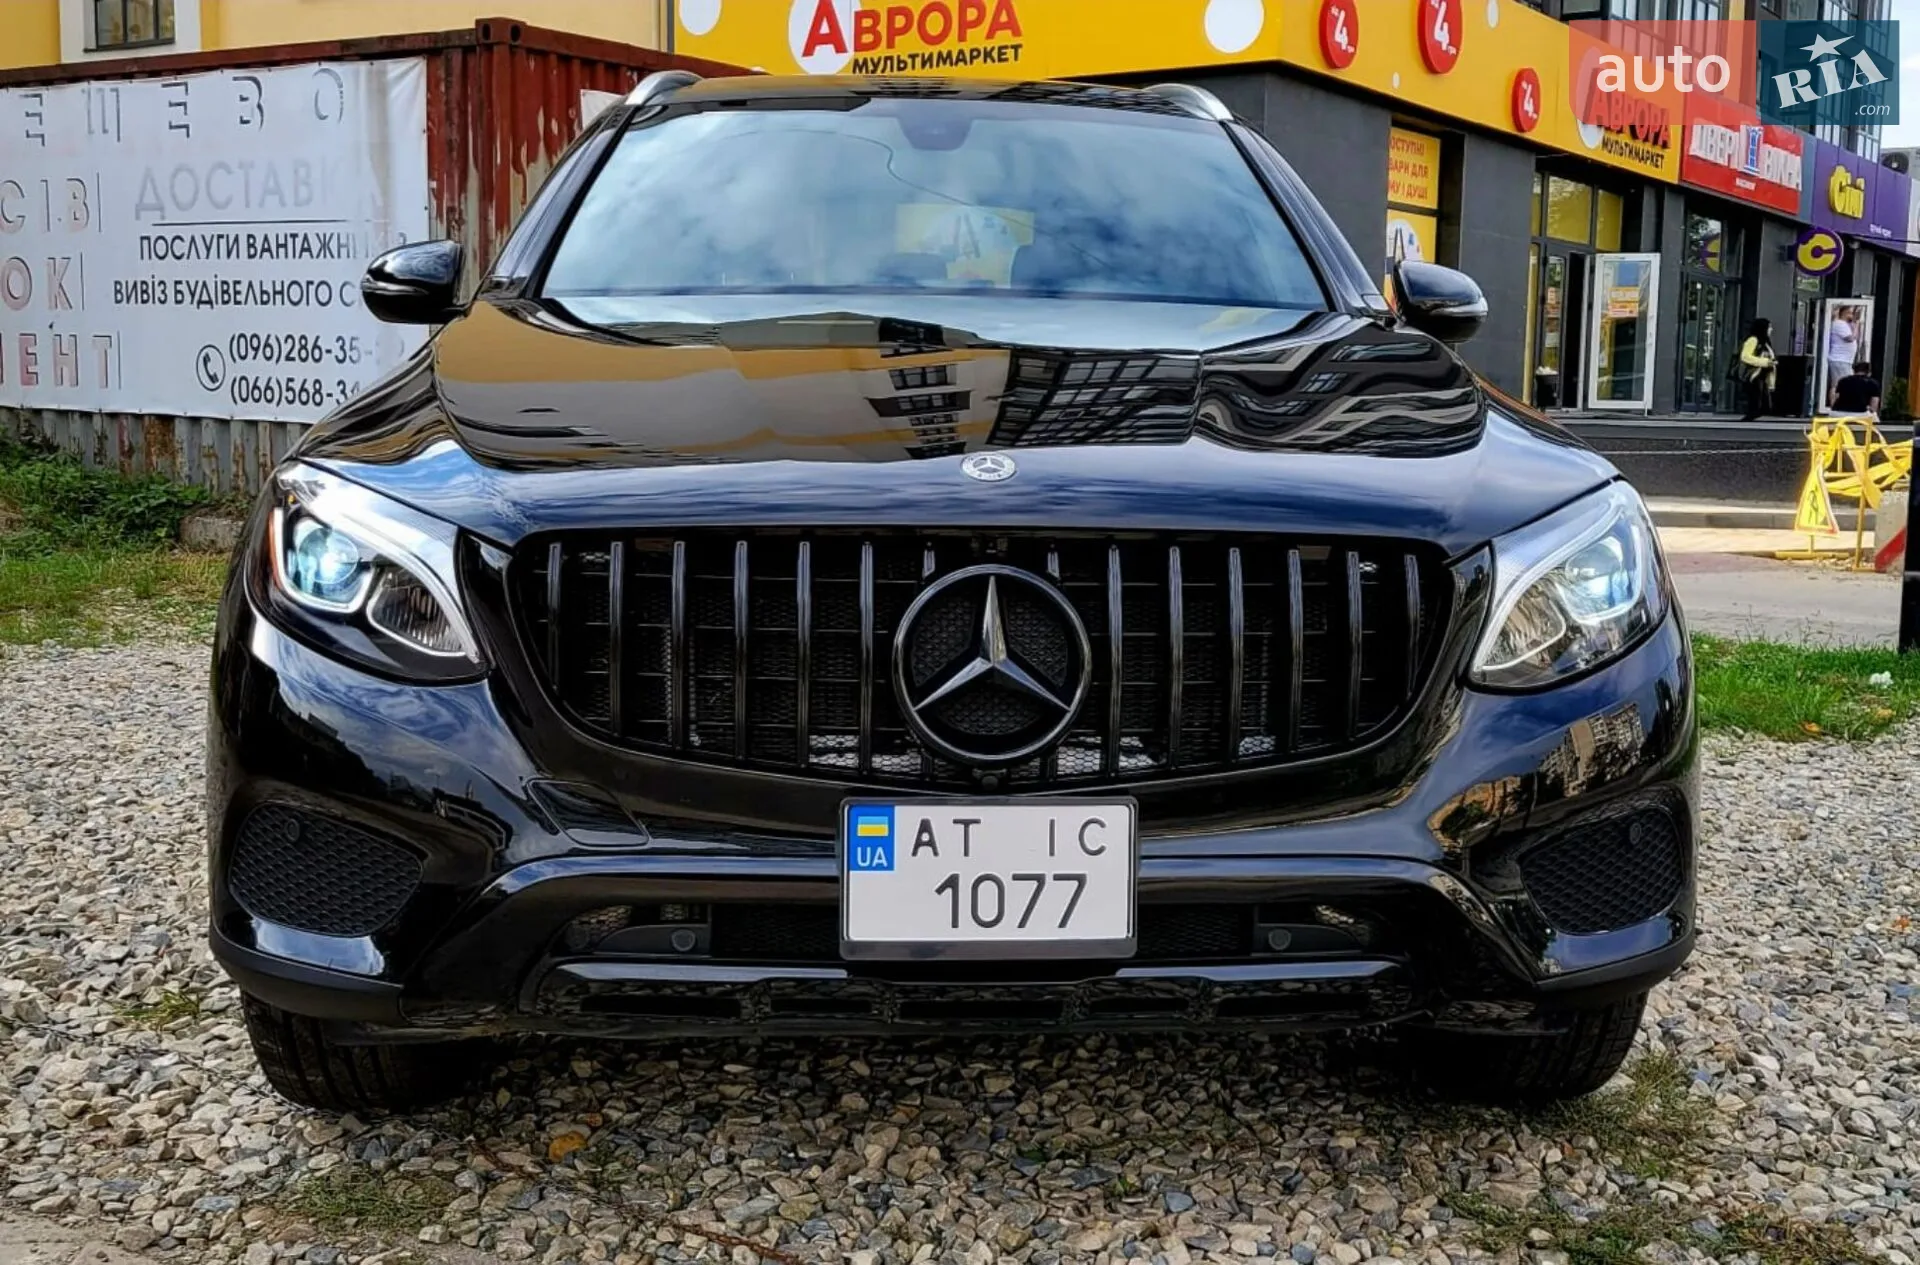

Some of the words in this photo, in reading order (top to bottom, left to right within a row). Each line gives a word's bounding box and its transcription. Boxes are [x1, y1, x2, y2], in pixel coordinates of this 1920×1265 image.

[802, 0, 1023, 57] АВРОРА
[1334, 9, 1348, 50] 4
[1433, 1, 1449, 50] 4
[852, 44, 1023, 75] МУЛЬТИМАРКЕТ
[1523, 83, 1534, 118] 4
[1602, 134, 1665, 169] МУЛЬТИМАРКЕТ
[134, 157, 382, 221] ДОСТАВК
[139, 233, 240, 261] ПОСЛУГИ
[339, 280, 356, 307] С
[0, 332, 113, 389] ЕНТ
[229, 332, 404, 364] (096)286-35-
[911, 818, 981, 857] AT
[1049, 817, 1107, 857] IC
[857, 847, 889, 867] UA
[934, 873, 1087, 928] 1077
